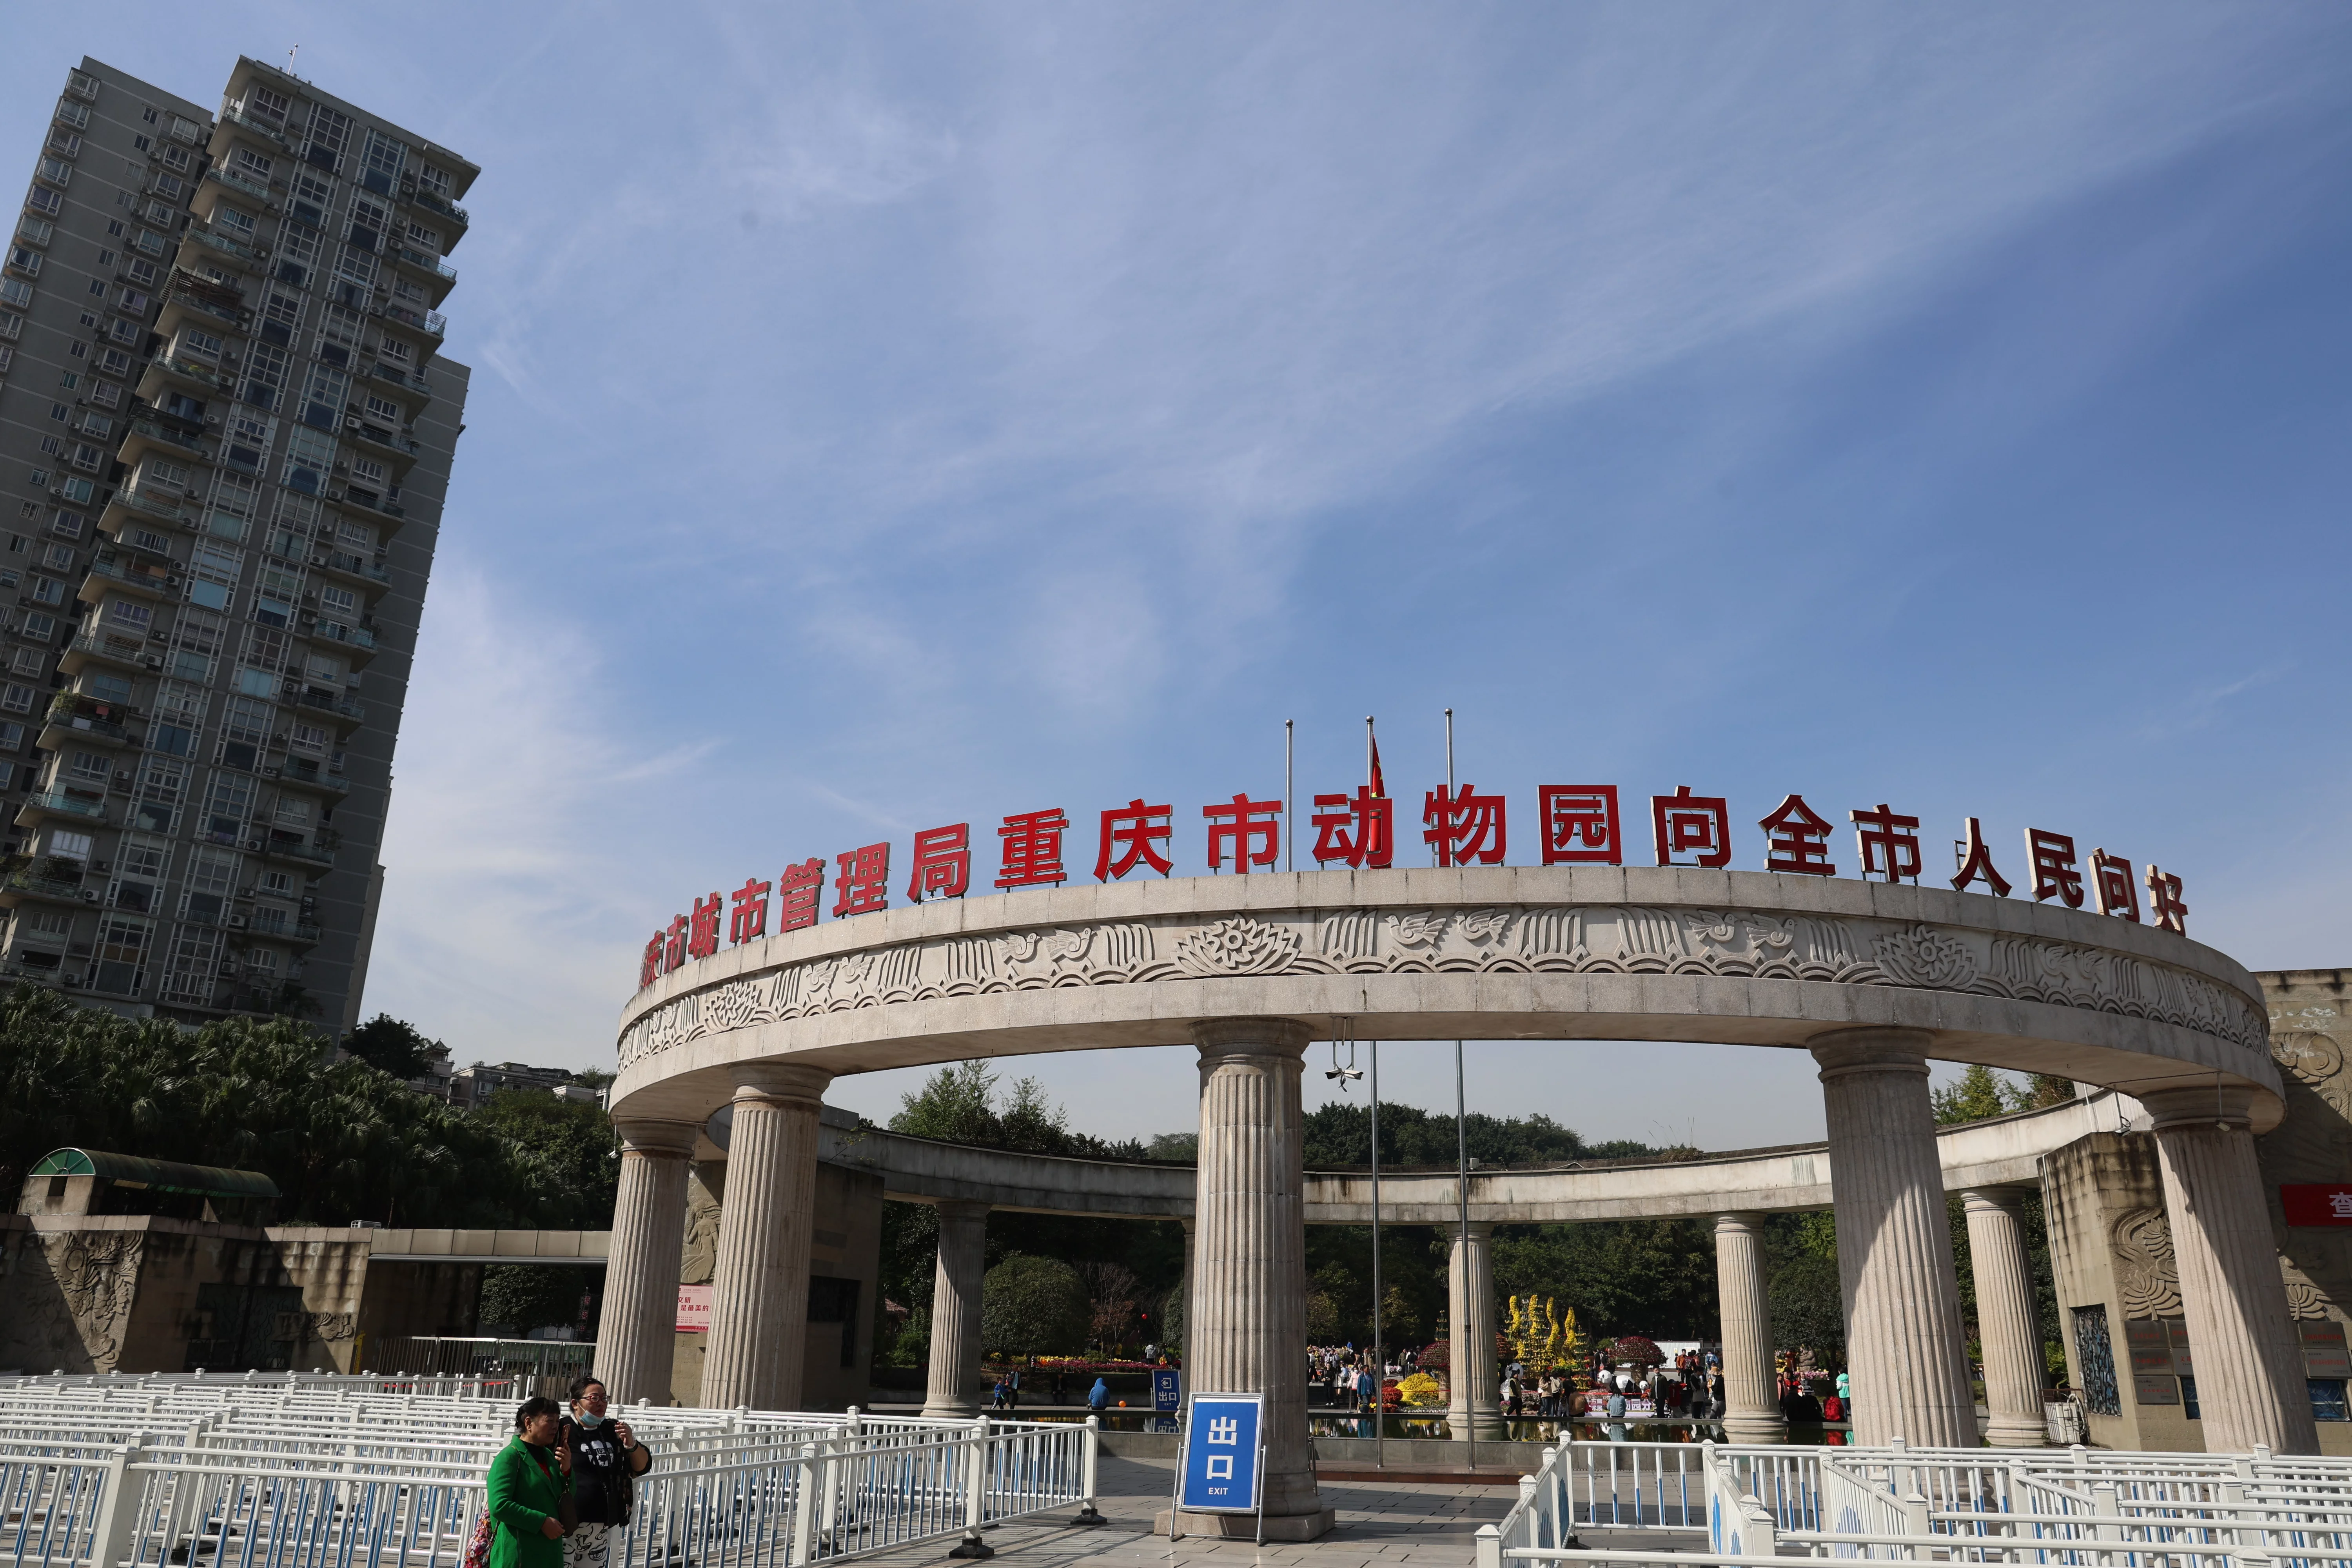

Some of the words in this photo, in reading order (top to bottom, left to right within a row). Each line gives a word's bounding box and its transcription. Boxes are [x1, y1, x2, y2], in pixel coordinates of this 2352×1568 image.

[638, 783, 2188, 990] 庆市城市管理局重庆市动物园向全市人民问好
[2329, 1192, 2352, 1217] 查
[579, 1296, 591, 1342] 游客中
[1159, 1391, 1176, 1401] 出口
[1207, 1417, 1237, 1480] 出口
